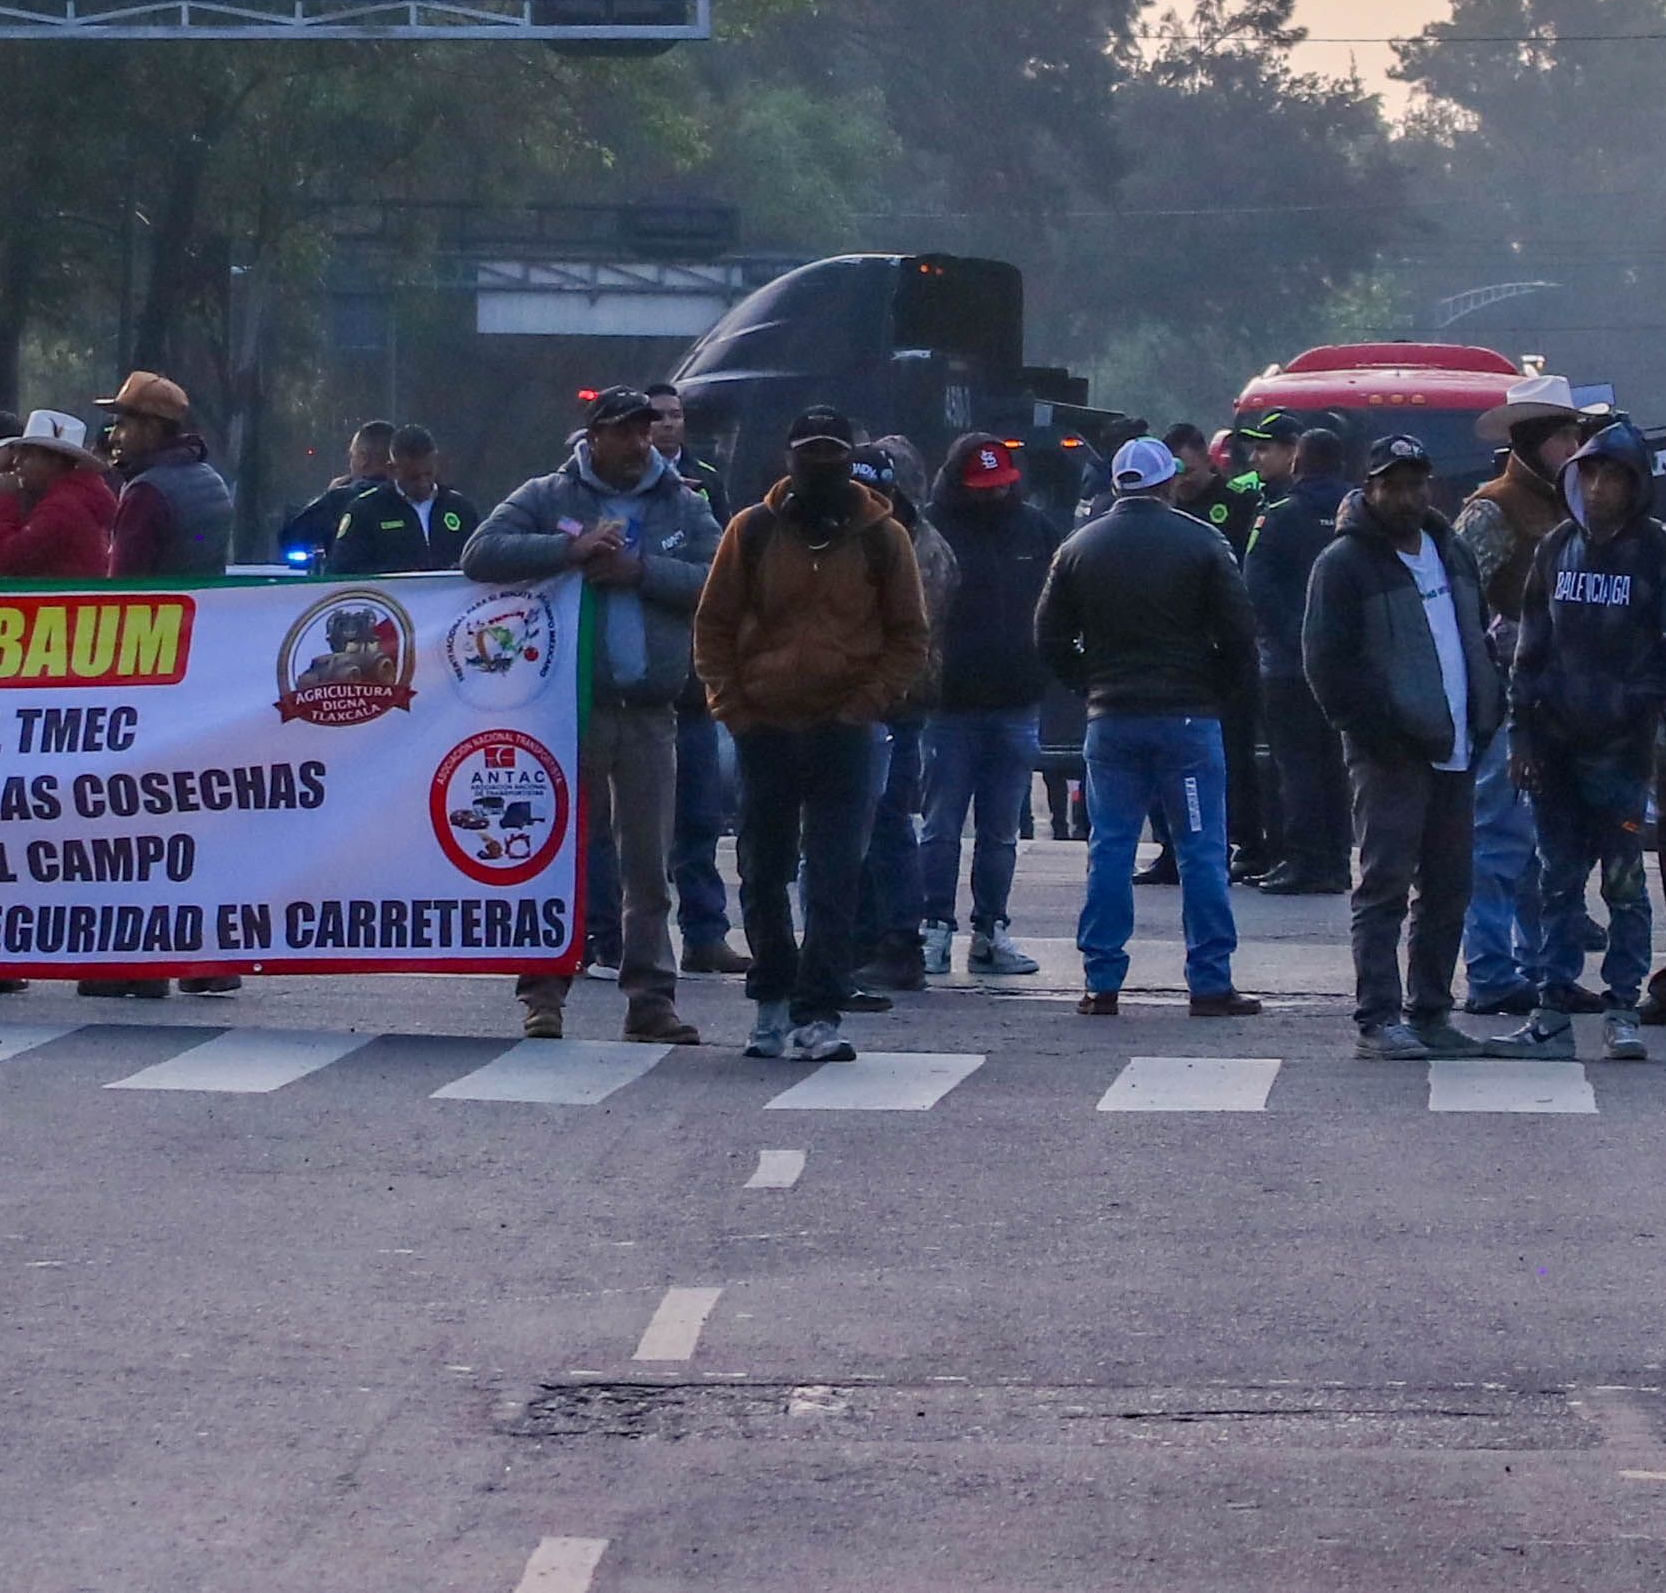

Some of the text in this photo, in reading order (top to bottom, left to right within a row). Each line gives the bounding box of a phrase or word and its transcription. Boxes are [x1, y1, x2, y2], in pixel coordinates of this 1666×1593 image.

[295, 686, 392, 705] AGRICULTURA
[323, 698, 366, 711] DIGNA
[311, 704, 381, 721] TLAXCALA
[16, 706, 138, 753] TMEC
[73, 761, 326, 819] COSECHAS
[471, 770, 546, 784] ANTAC
[27, 833, 195, 883] CAMPO
[217, 903, 272, 950] EN
[285, 898, 565, 951] CARRETERAS
